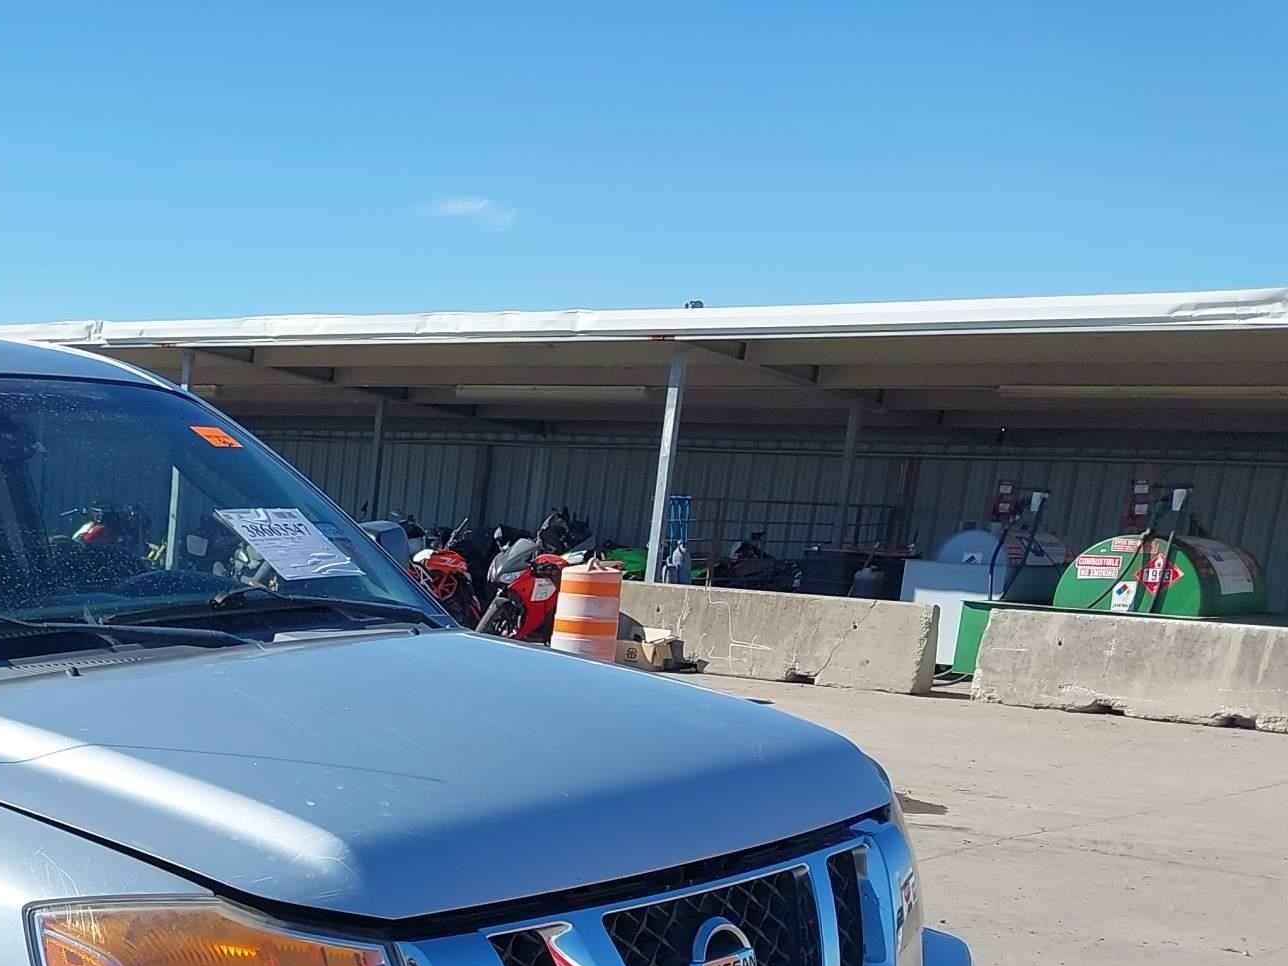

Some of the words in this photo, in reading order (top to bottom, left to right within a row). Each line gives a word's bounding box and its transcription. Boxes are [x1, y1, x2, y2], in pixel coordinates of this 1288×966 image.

[241, 523, 312, 538] 38663547
[1078, 557, 1119, 567] COMBUSTIBLE
[1080, 568, 1089, 576] NO
[1089, 568, 1117, 578] SMOKING
